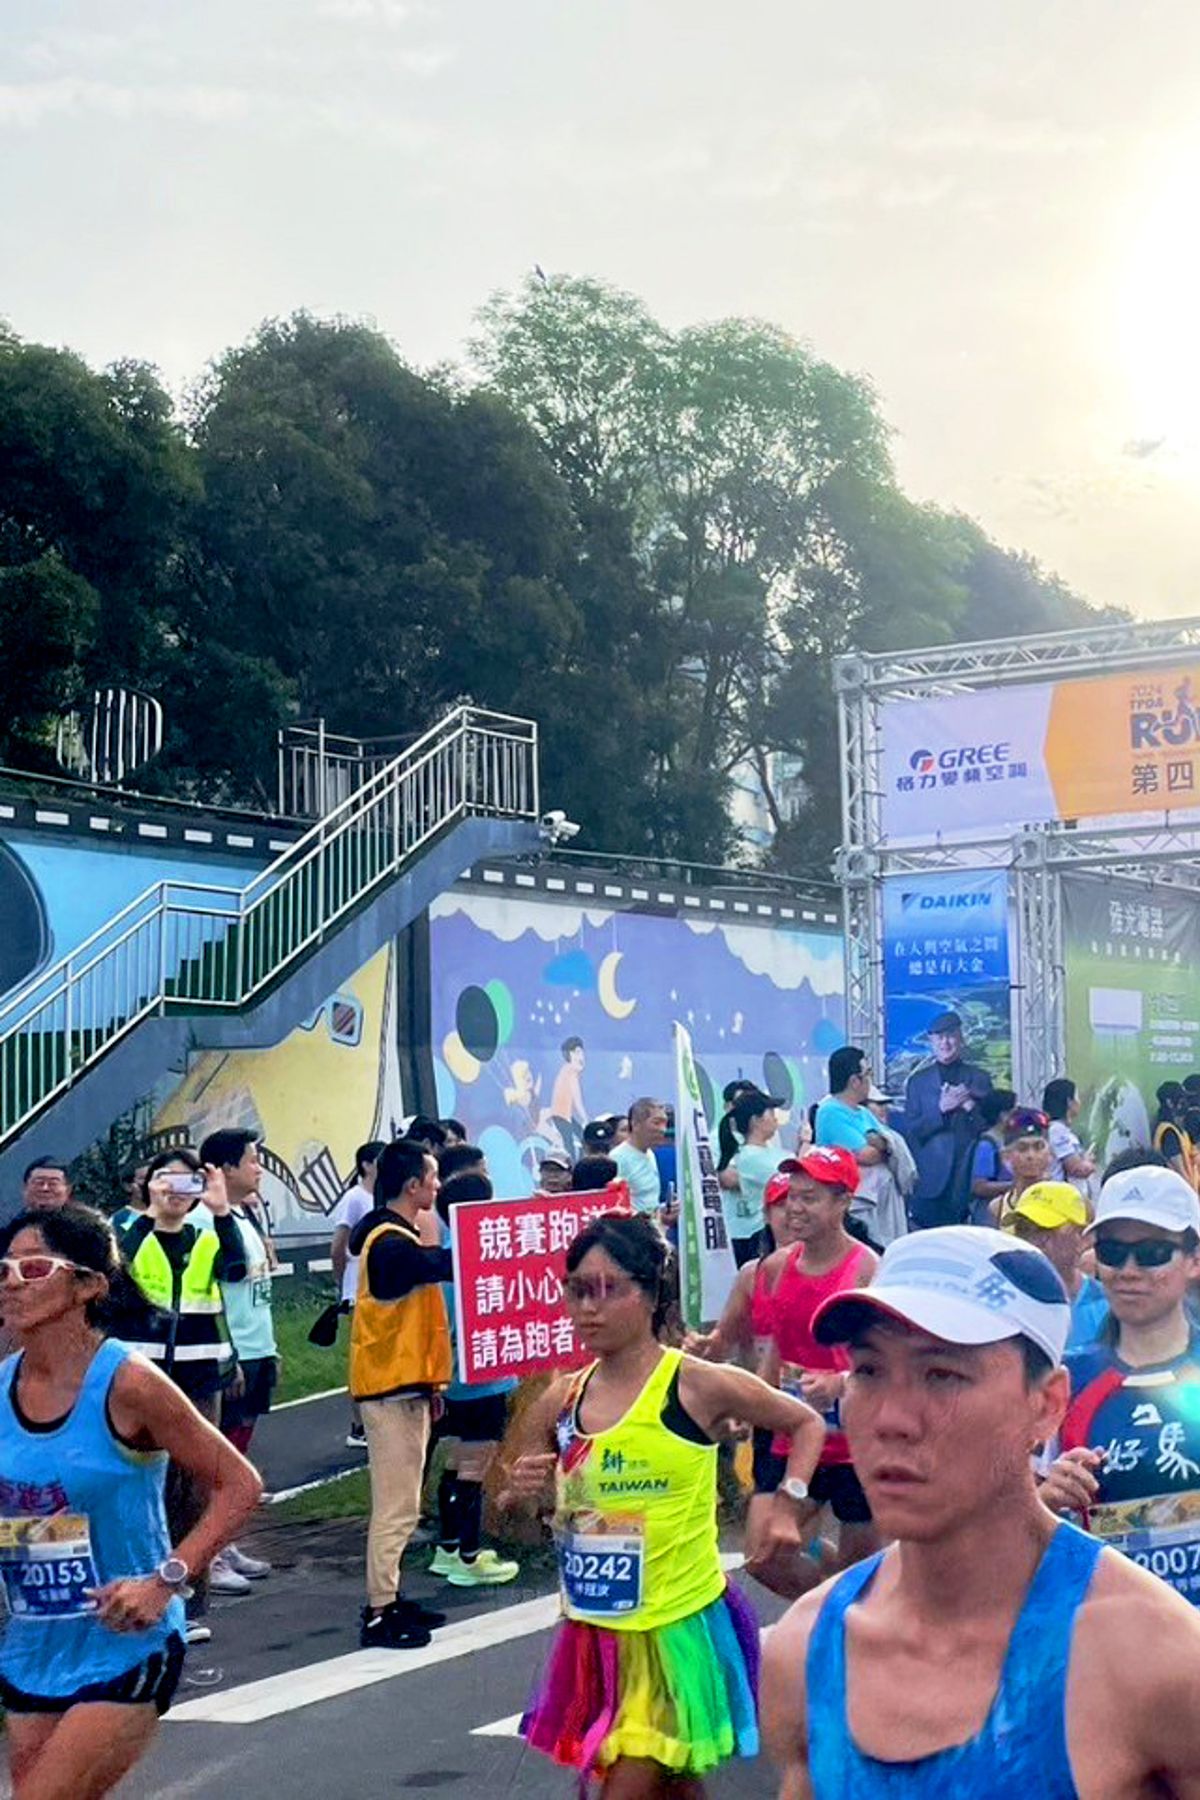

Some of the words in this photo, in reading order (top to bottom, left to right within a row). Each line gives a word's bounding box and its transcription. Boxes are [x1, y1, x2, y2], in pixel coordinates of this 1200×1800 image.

[939, 742, 1011, 769] GREE
[921, 892, 991, 910] DAIKIN
[475, 1266, 564, 1316] 請小心
[471, 1316, 586, 1370] 請為跑者
[599, 1478, 669, 1493] TAIWAN
[21, 1560, 87, 1587] 20153
[564, 1551, 632, 1581] 20242
